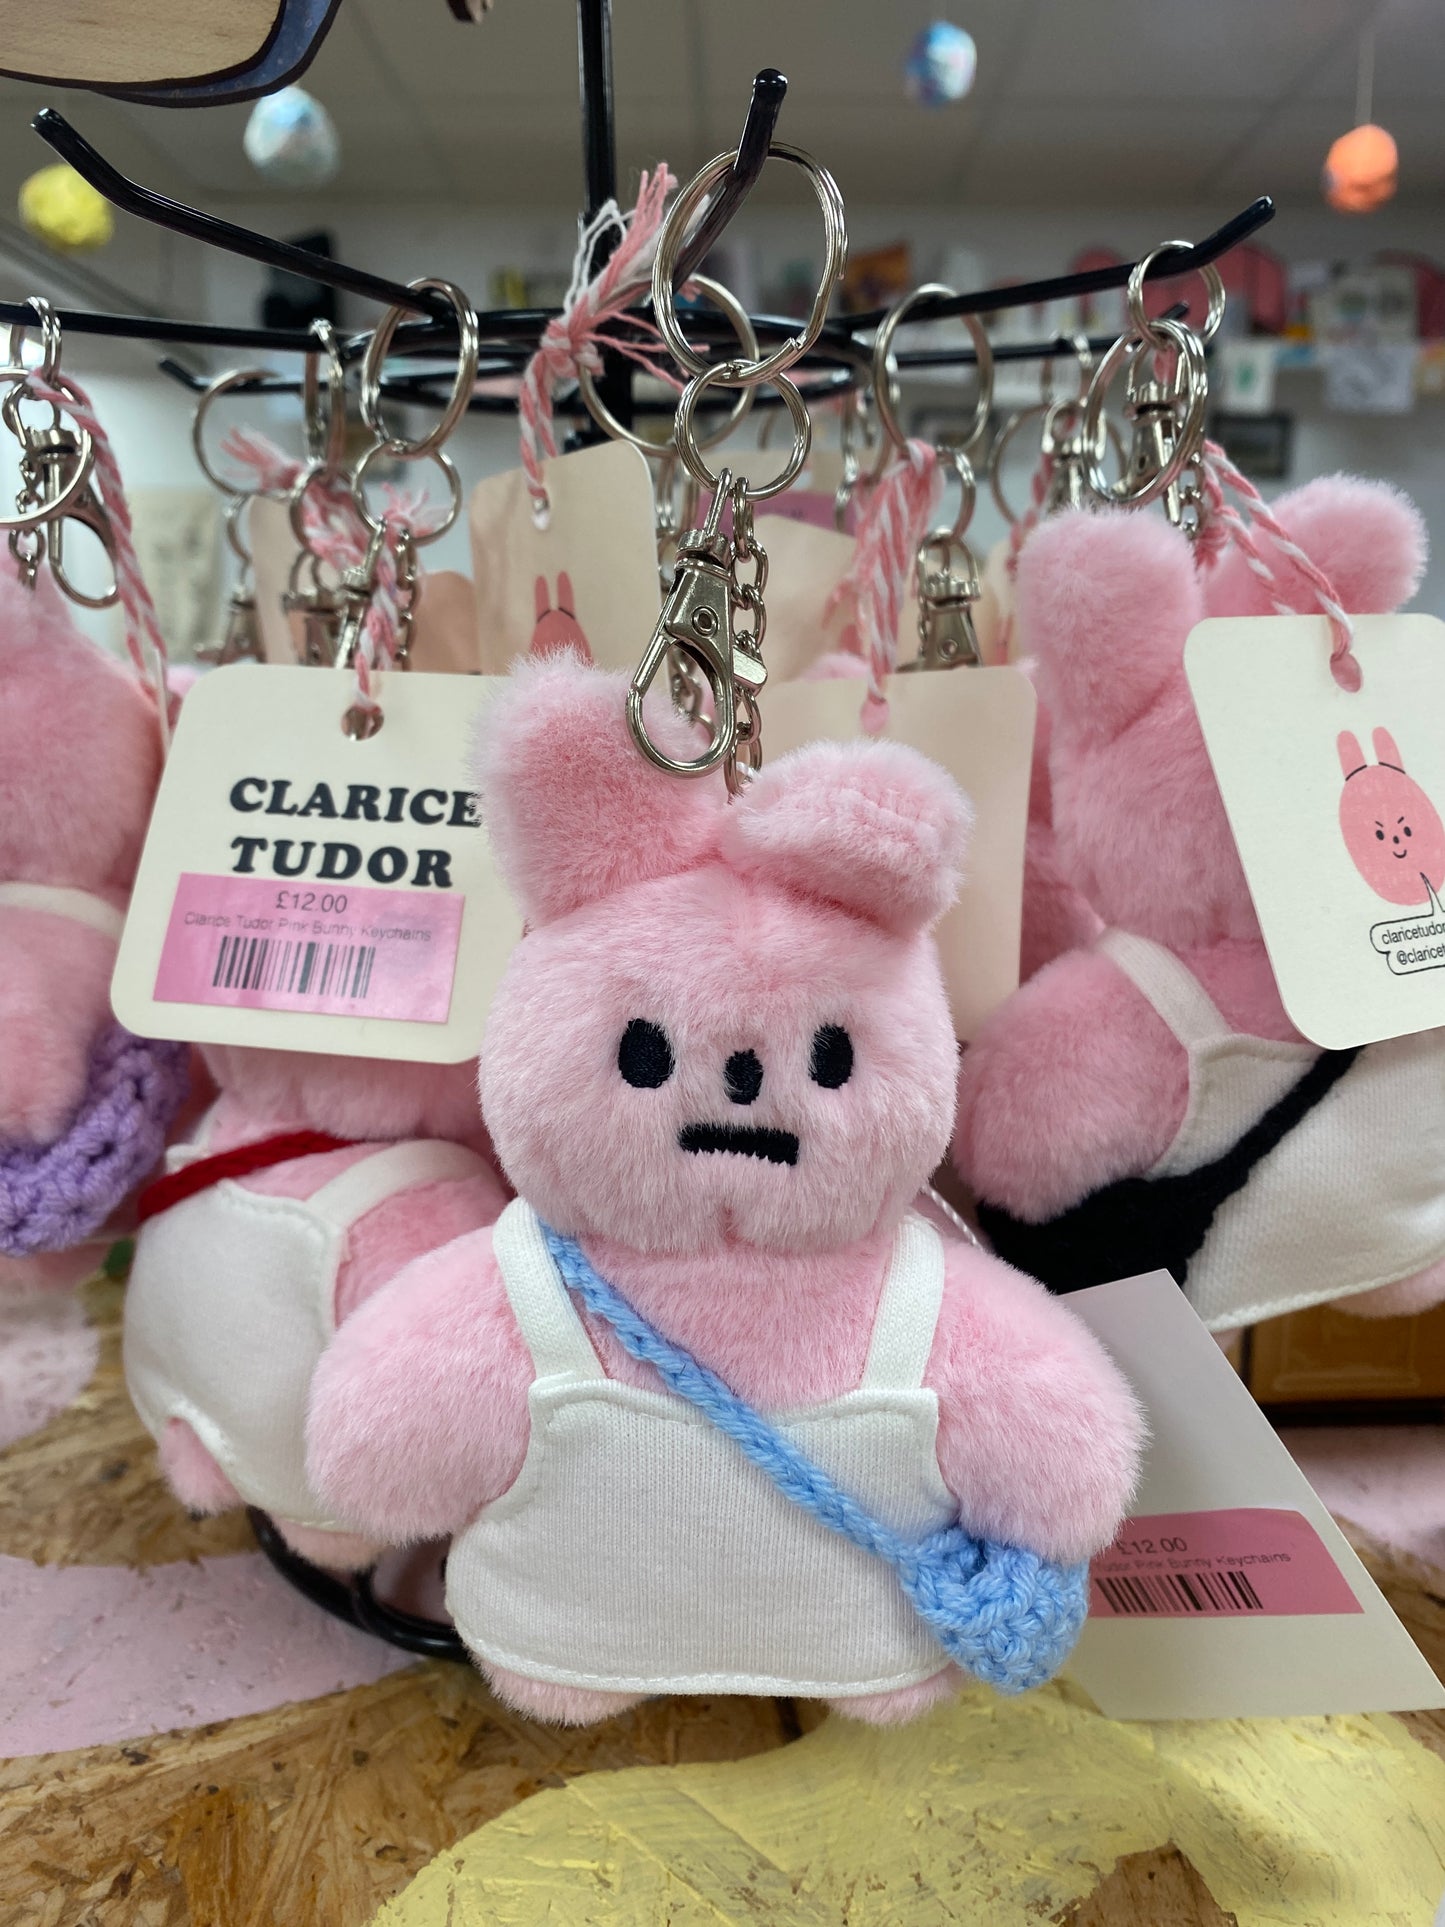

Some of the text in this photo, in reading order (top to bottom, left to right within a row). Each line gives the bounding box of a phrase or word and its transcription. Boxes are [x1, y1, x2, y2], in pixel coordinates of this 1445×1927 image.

[229, 777, 482, 827] CLARICE
[231, 836, 453, 887] TUDOR
[275, 890, 348, 914] £12.00
[184, 911, 433, 942] Clarice Tudor Pink Bunny Keychains
[1216, 1552, 1291, 1567] Keychains
